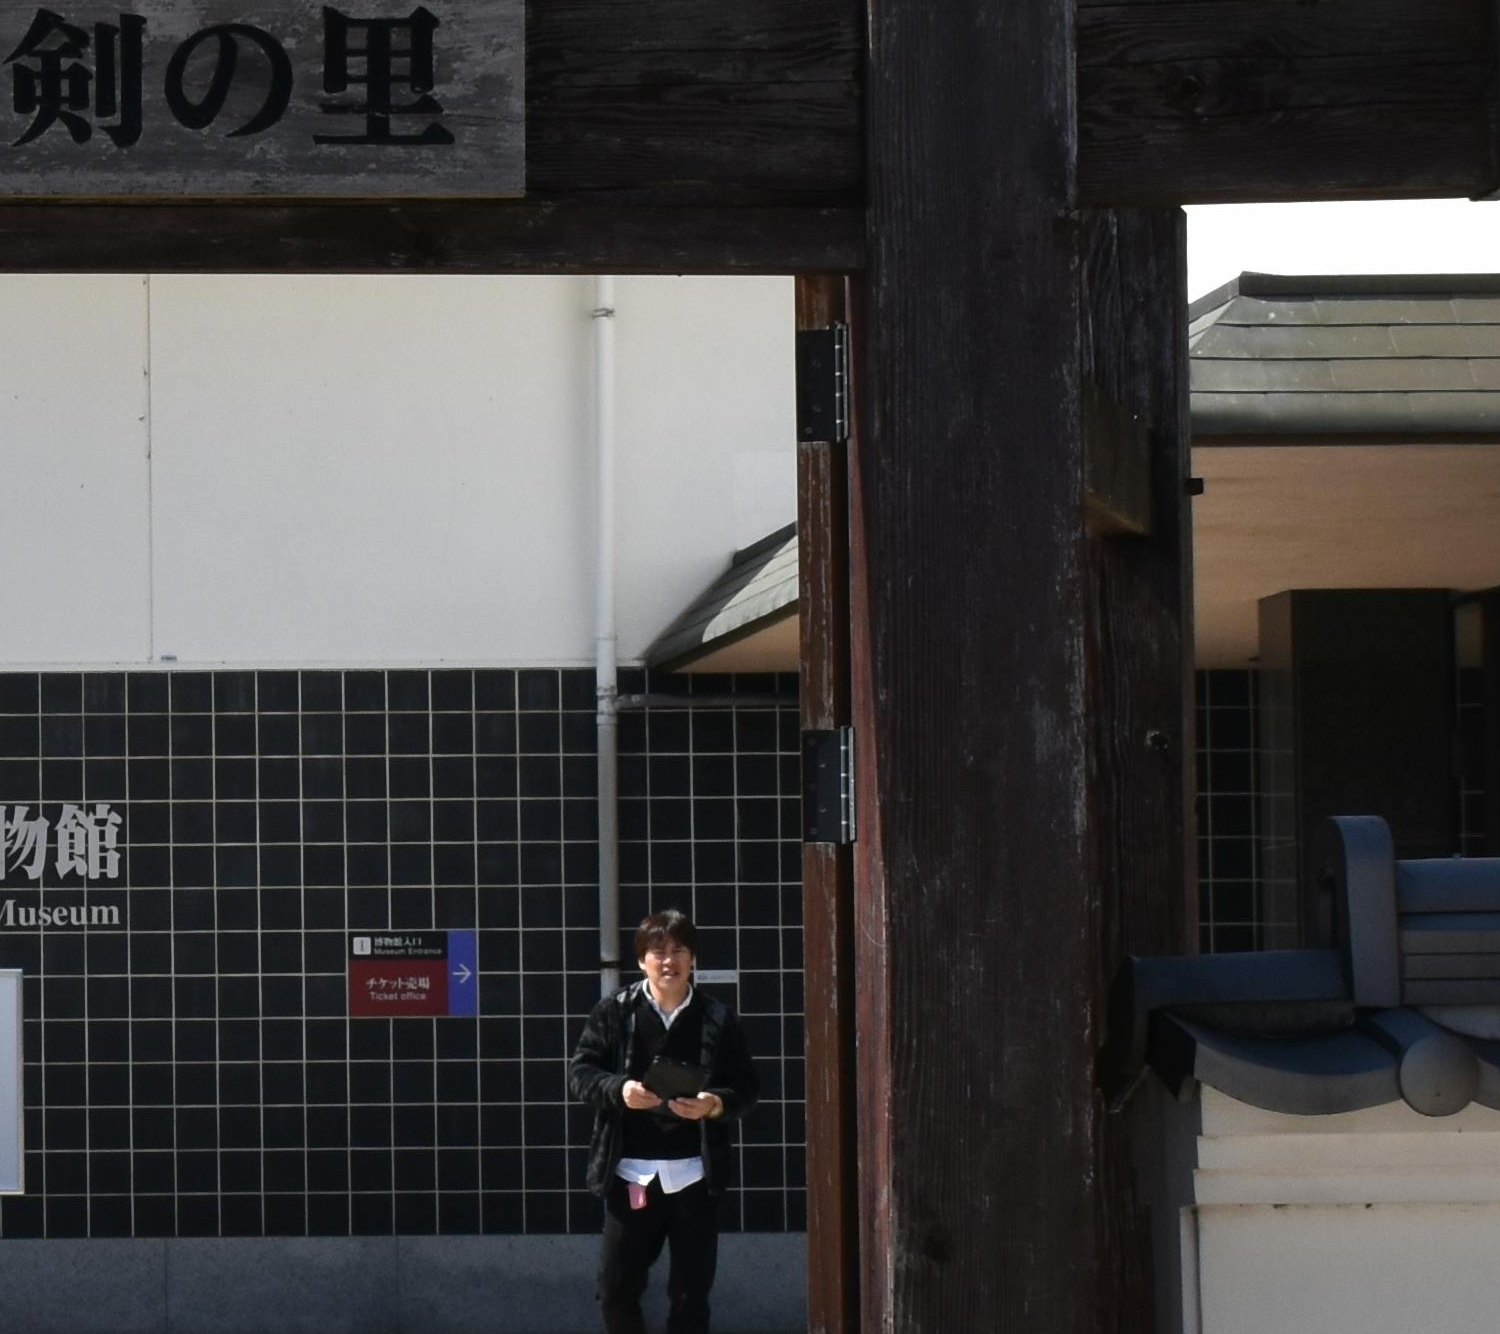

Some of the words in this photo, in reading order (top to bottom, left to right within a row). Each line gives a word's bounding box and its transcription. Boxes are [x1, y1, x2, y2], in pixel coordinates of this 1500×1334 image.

[366, 977, 431, 990] チケット売場
[370, 991, 398, 1001] Ticket
[400, 991, 427, 1001] office
